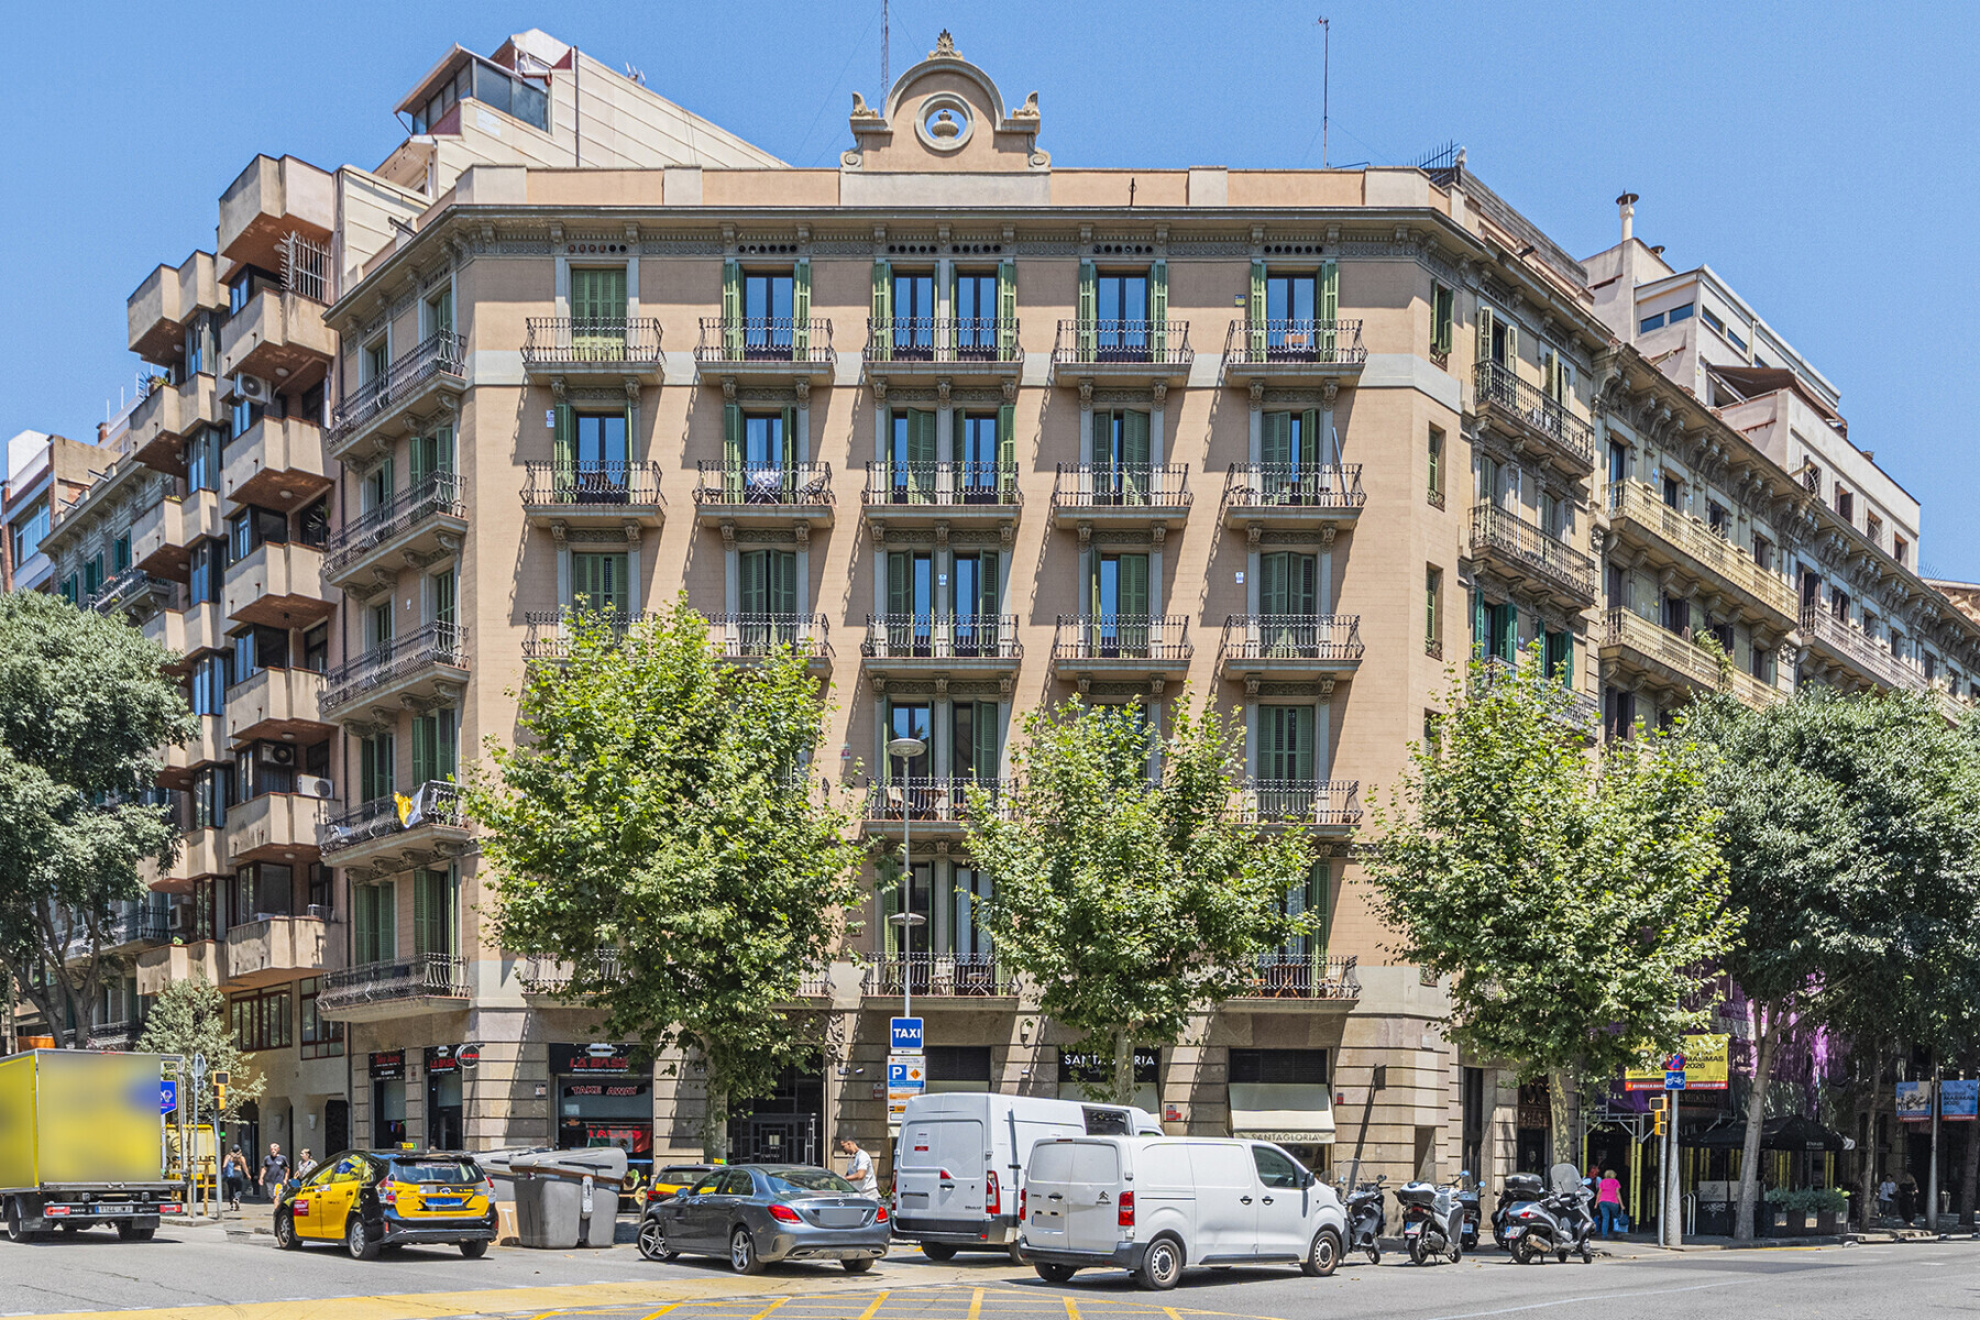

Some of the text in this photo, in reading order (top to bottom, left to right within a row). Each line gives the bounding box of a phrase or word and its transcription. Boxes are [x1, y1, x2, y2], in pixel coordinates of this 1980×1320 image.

[893, 1028, 921, 1038] TAXI
[569, 1058, 588, 1068] LA
[892, 1066, 903, 1079] P
[571, 1085, 638, 1096] TAKE AWAY
[1252, 1133, 1319, 1141] SANTAGLORIA
